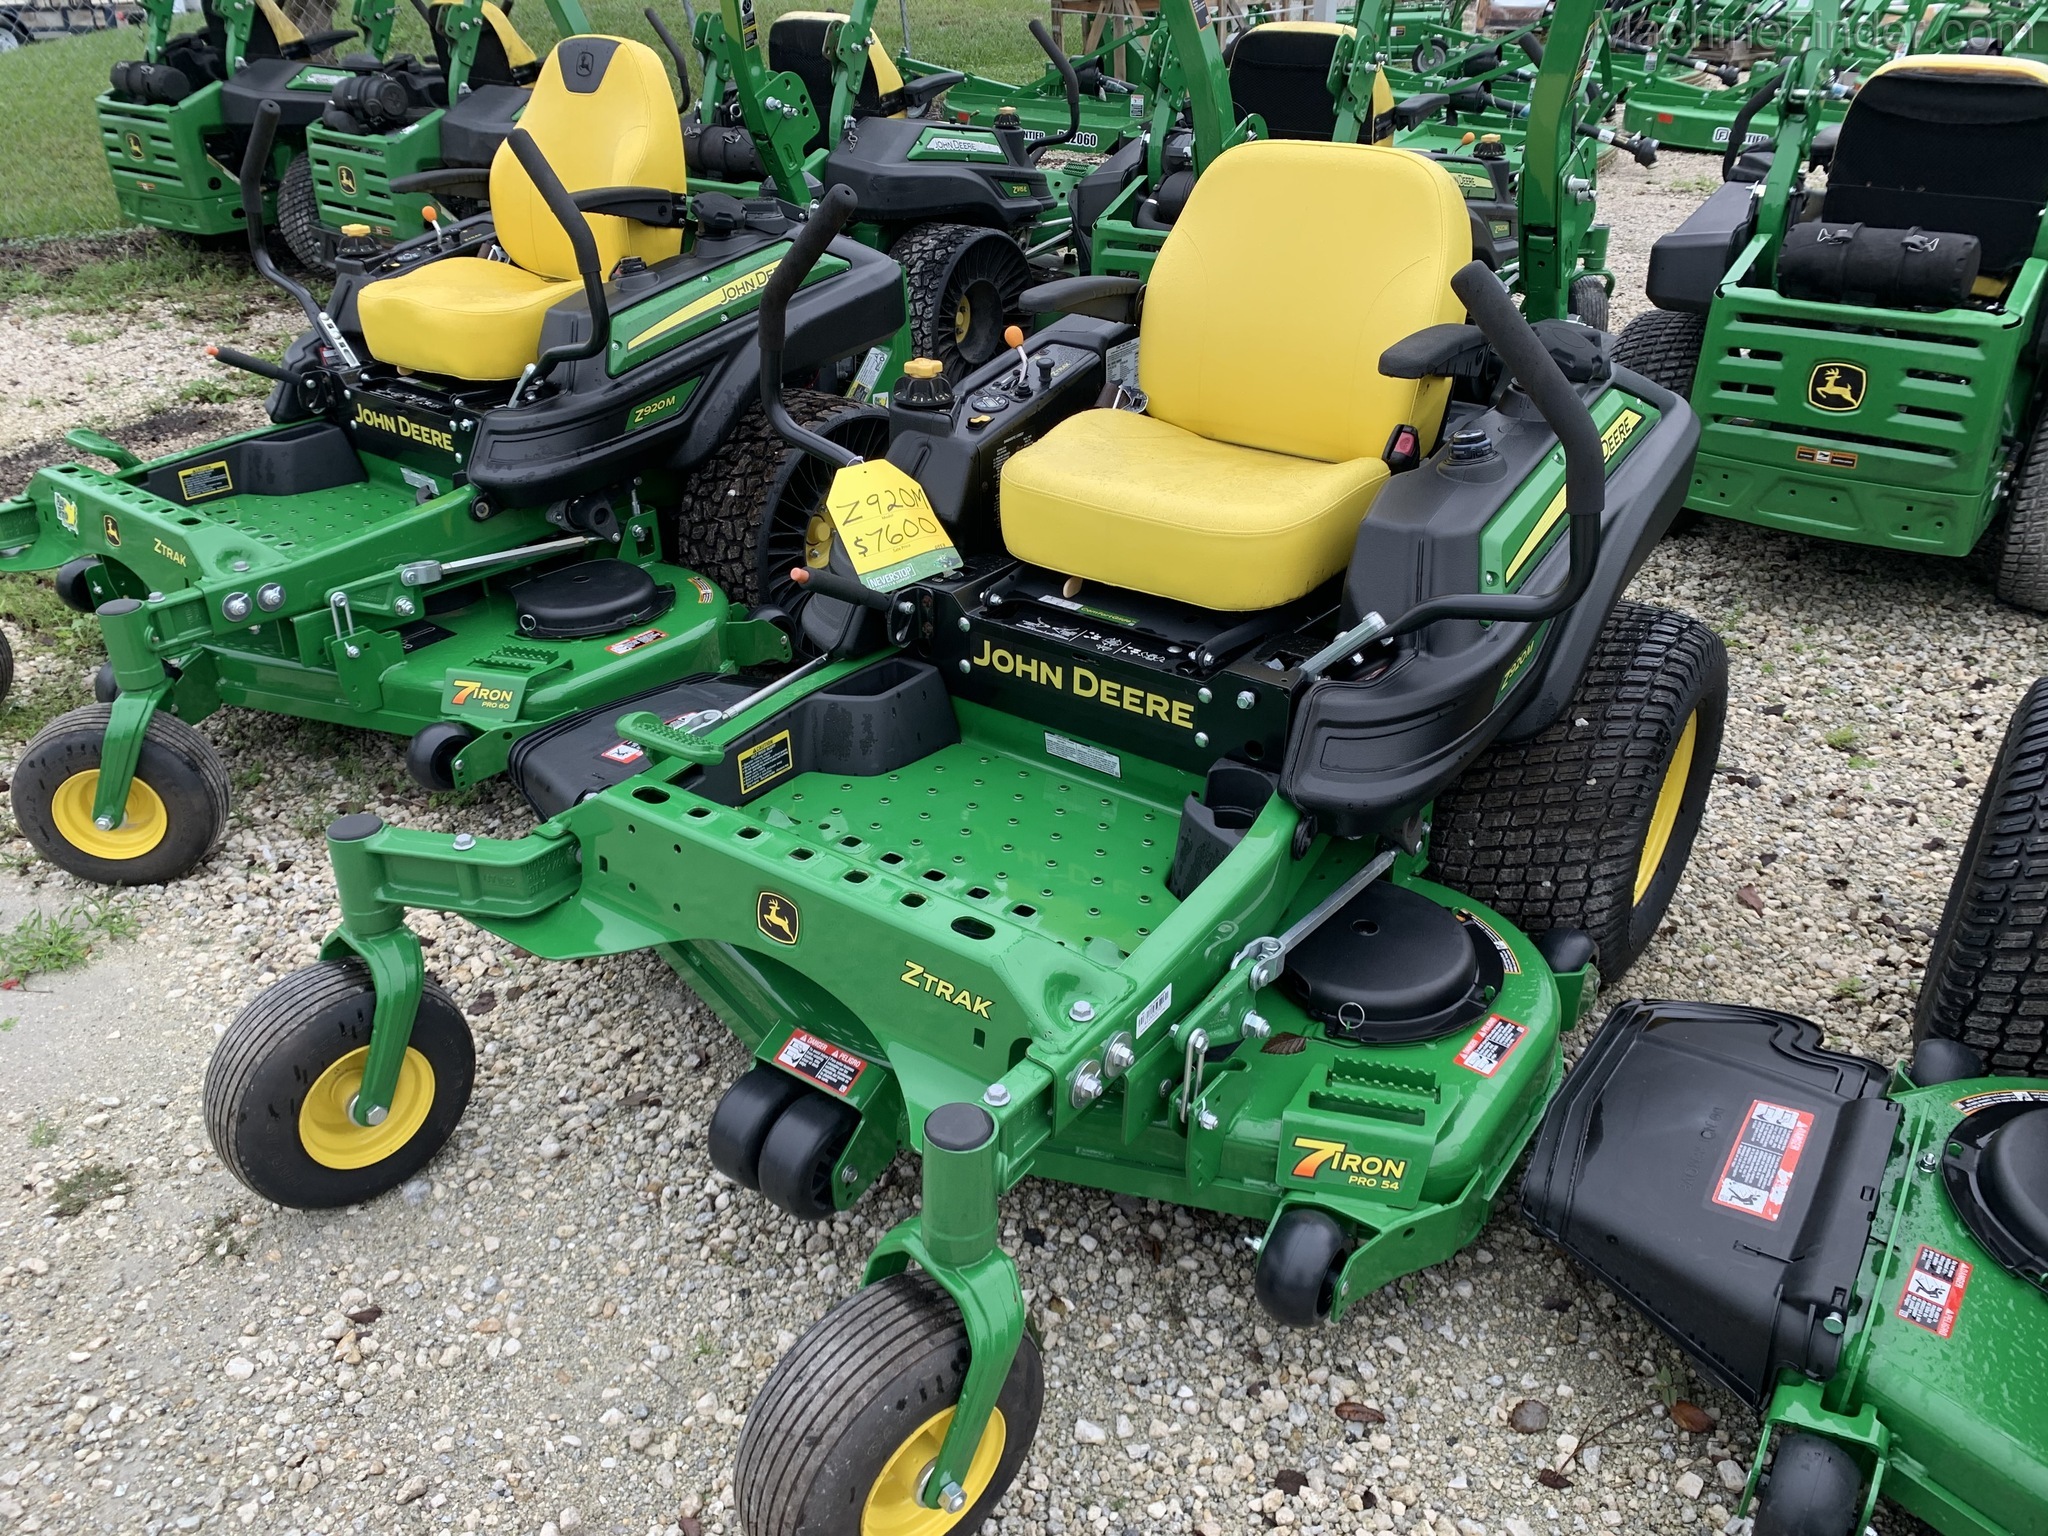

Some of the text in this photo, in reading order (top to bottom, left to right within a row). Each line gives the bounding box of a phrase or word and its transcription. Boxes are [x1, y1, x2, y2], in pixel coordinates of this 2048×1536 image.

[935, 140, 977, 151] JOHN DEERE
[720, 277, 756, 304] JOHN
[634, 395, 676, 423] Z920M
[355, 403, 454, 452] JOHN DEERE
[1600, 416, 1632, 460] DEERE
[153, 537, 187, 568] ZTRAK
[853, 516, 938, 558] $7600
[869, 566, 913, 588] NEVERSTOP
[973, 639, 1063, 690] JOHN
[1073, 665, 1195, 730] DEERE
[481, 700, 510, 710] PRO 60
[900, 959, 994, 1020] ZTRAK
[807, 1036, 862, 1068] DANGER PELIGRO
[1348, 1175, 1400, 1192] PRO 54
